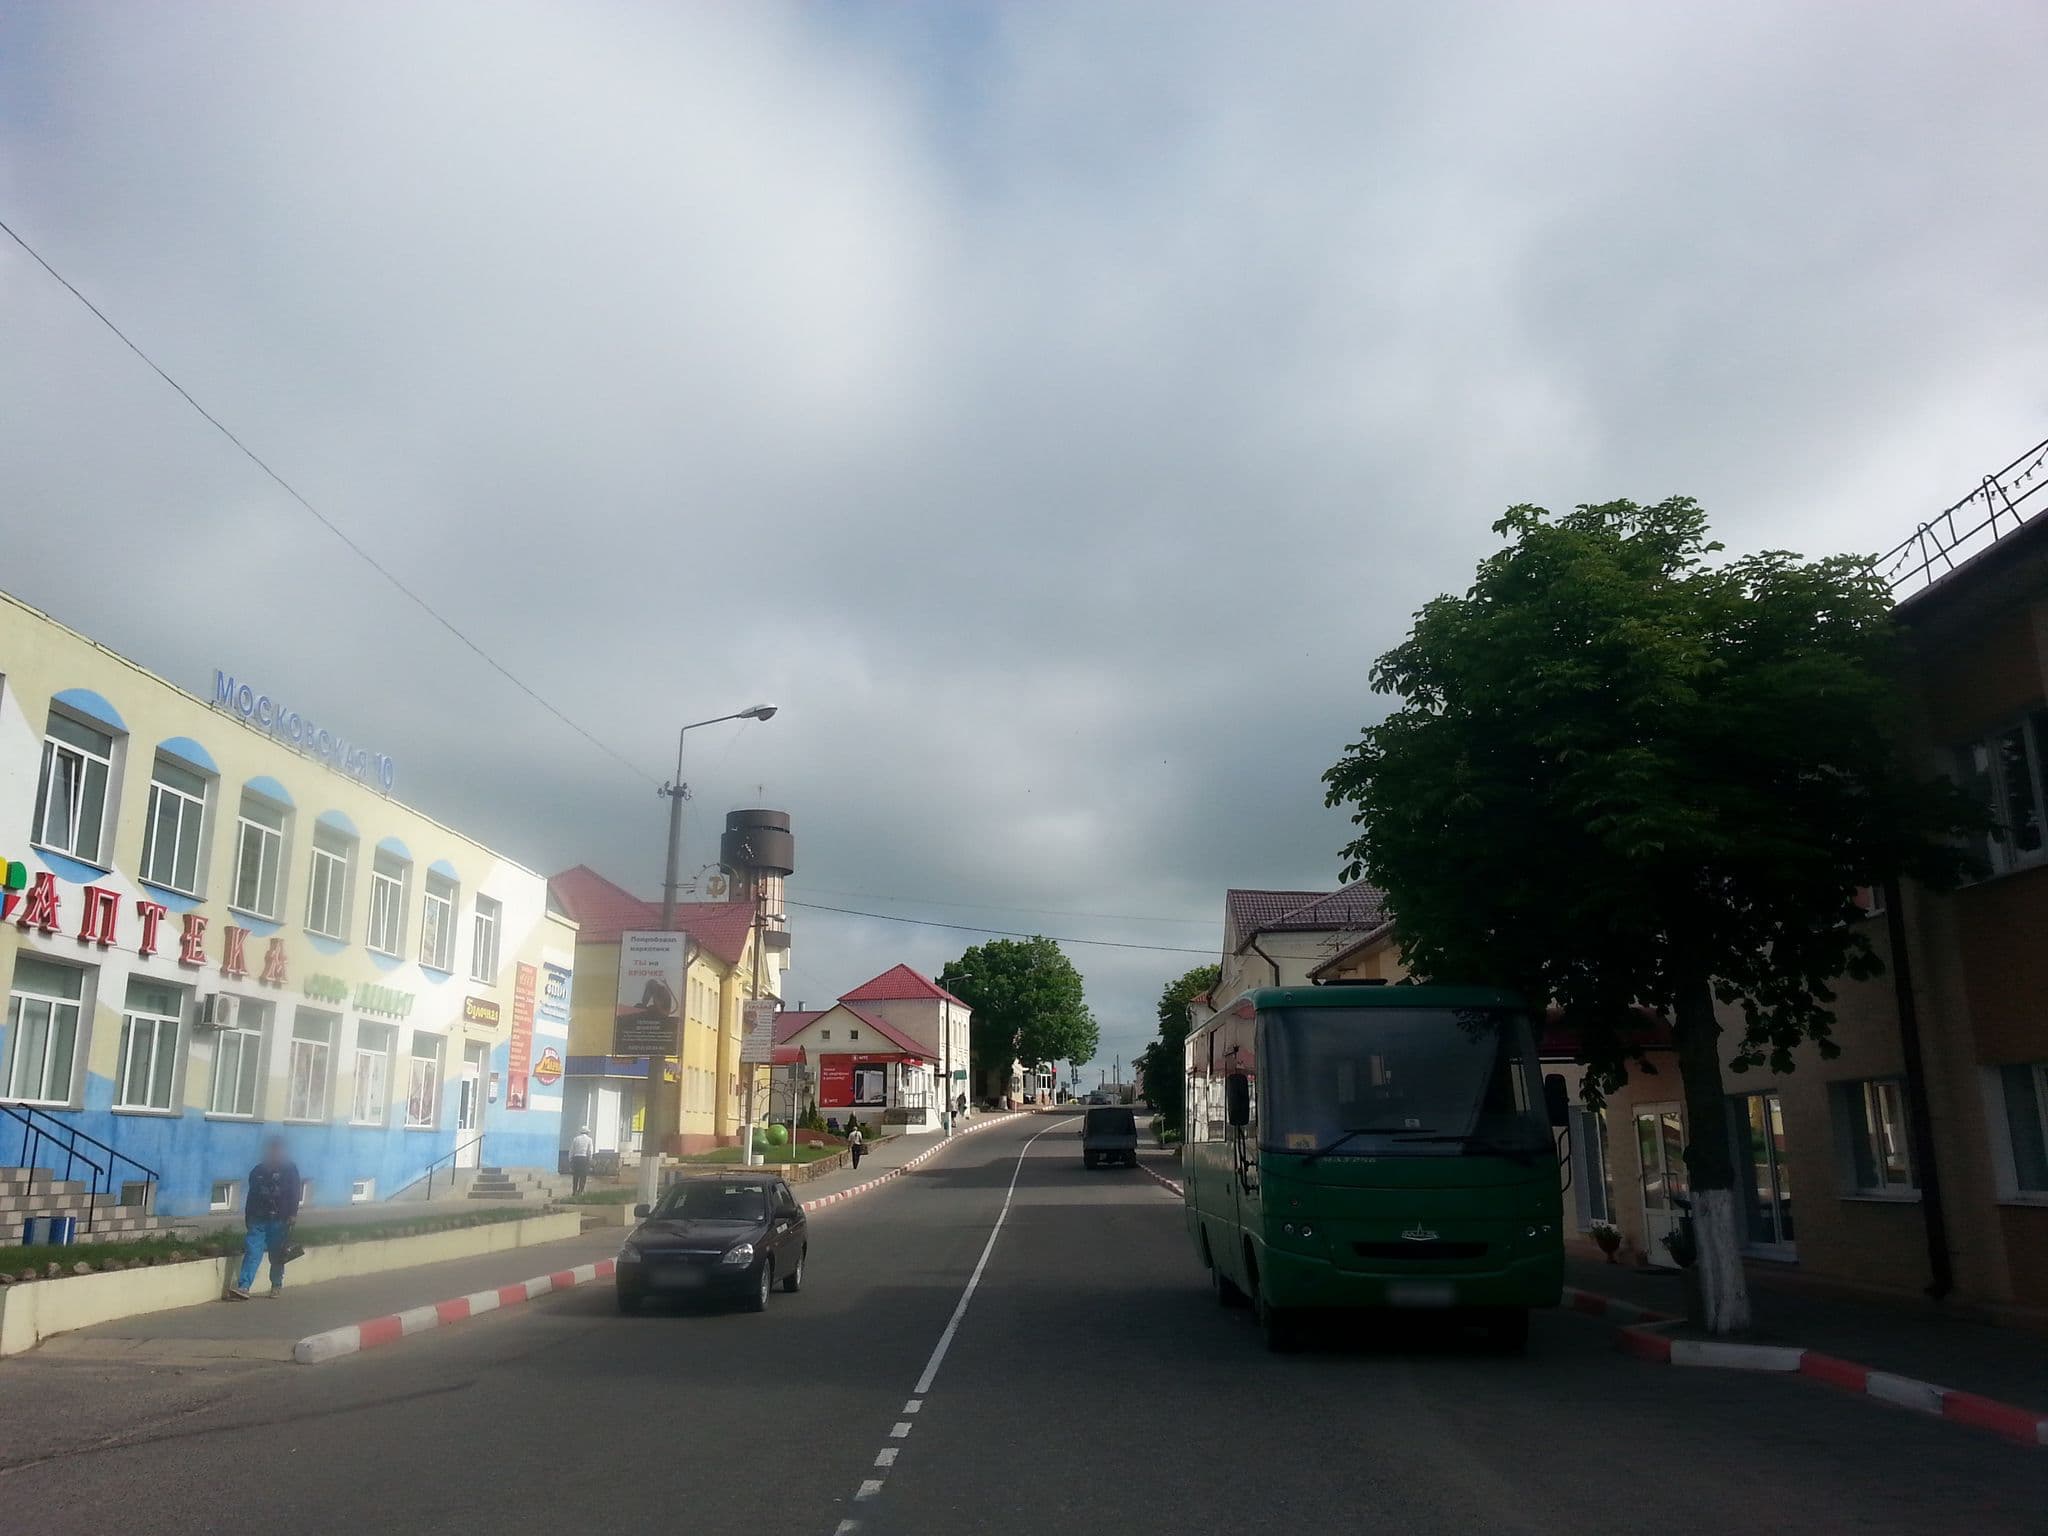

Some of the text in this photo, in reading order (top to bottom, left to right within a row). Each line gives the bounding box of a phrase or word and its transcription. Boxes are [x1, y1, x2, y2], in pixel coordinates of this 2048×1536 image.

[216, 670, 393, 790] МОСКОВСКАЯ 10
[17, 872, 290, 985] АПТЕКА
